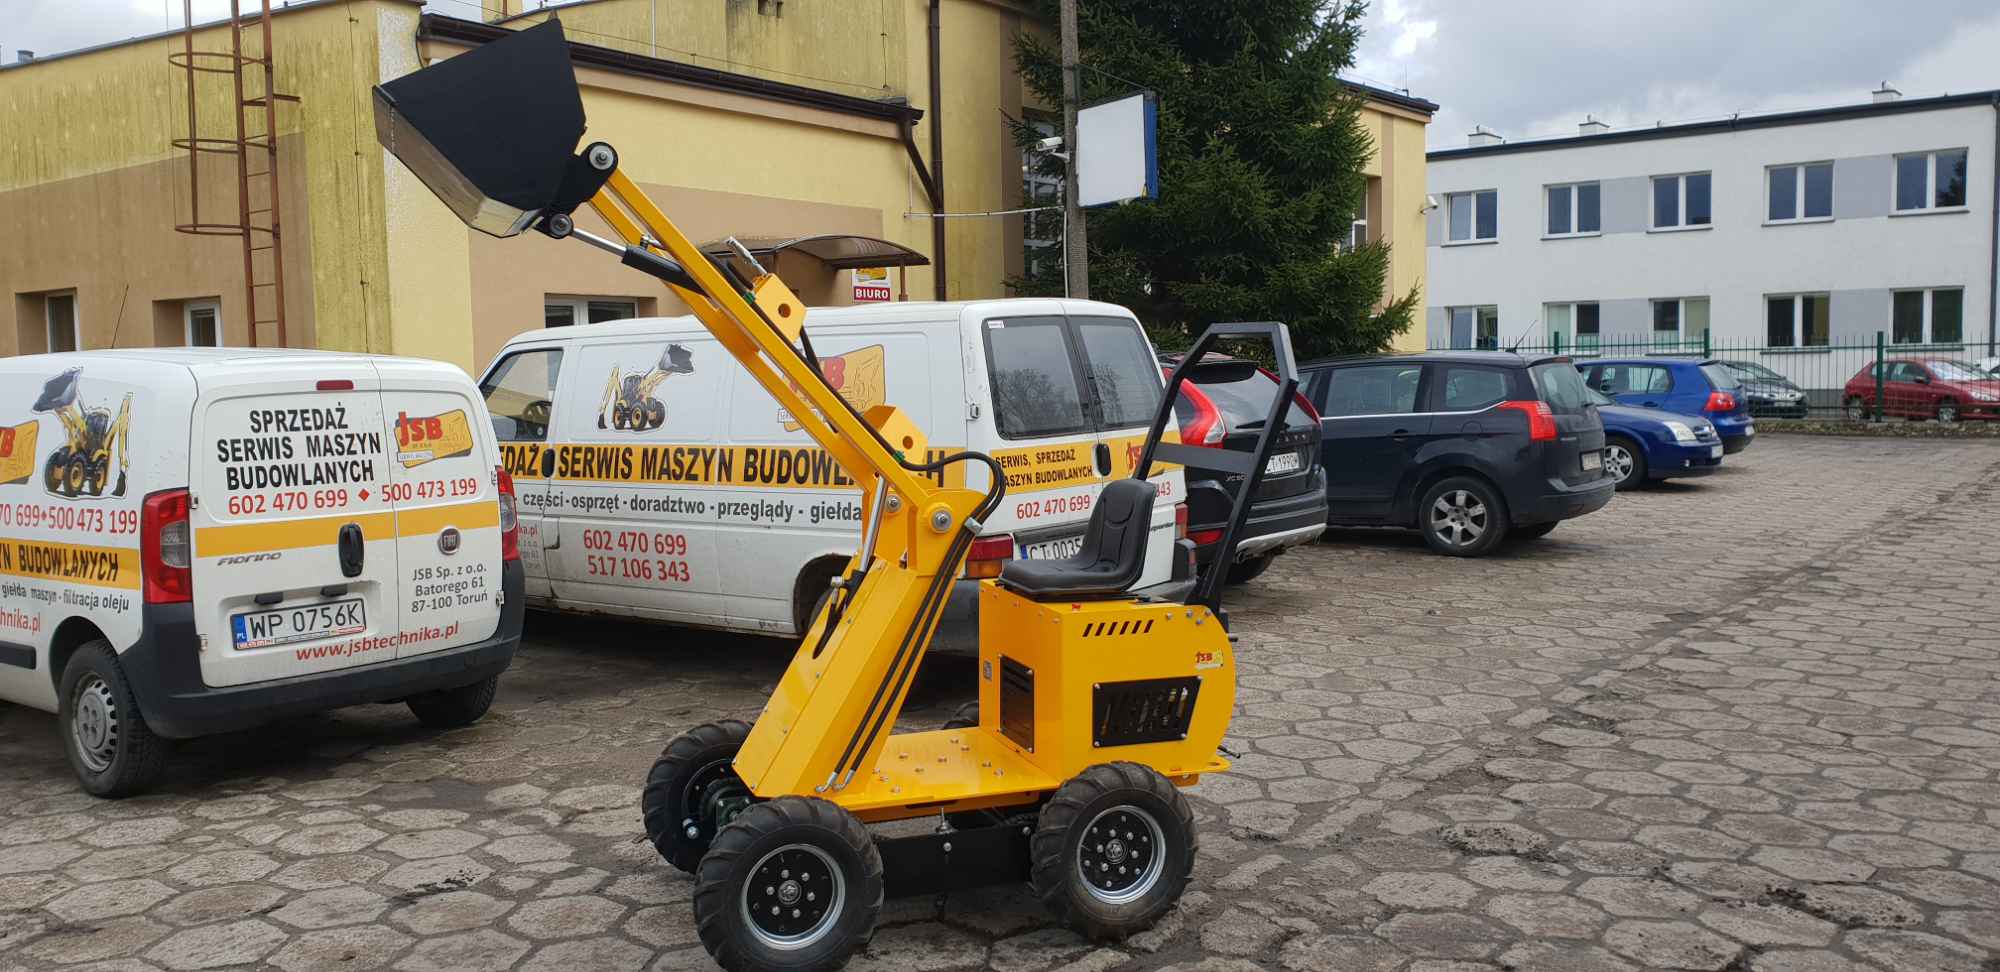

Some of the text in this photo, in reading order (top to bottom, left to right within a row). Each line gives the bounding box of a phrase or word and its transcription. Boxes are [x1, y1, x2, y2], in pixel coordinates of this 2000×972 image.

[856, 288, 889, 299] BIURO
[250, 402, 348, 433] SPRZEDAŻ
[398, 411, 443, 447] JSB
[217, 432, 381, 463] SERWIS MASZYN
[226, 459, 374, 490] BUDOWLANYCH
[558, 446, 633, 480] SERWIS
[641, 447, 734, 482] MASZYN
[1004, 466, 1093, 487] ASZYN BUDOWLANYCH
[229, 478, 477, 515] 602 470 699 500 473 199
[571, 494, 619, 513] osprzęt
[630, 494, 705, 514] doradztwo
[718, 499, 794, 523] przeglądy
[810, 501, 862, 524] giełda
[1017, 495, 1090, 520] 602 470 699
[16, 504, 40, 527] 699
[48, 506, 74, 530] 500
[77, 508, 103, 533] 473
[109, 509, 137, 534] 199
[584, 529, 687, 556] 602 470 699
[18, 544, 119, 582] BUDOWLANYCH
[412, 568, 433, 581] JSB
[436, 566, 454, 580] Sp.
[457, 566, 463, 575] z
[588, 555, 690, 582] 517 106 343
[411, 589, 488, 613] 87-100 Toruń
[415, 577, 485, 597] Batorego 61
[102, 594, 130, 613] oleju
[250, 602, 361, 639] WP 0756K
[296, 620, 459, 661] www.jsbtechnika.pl
